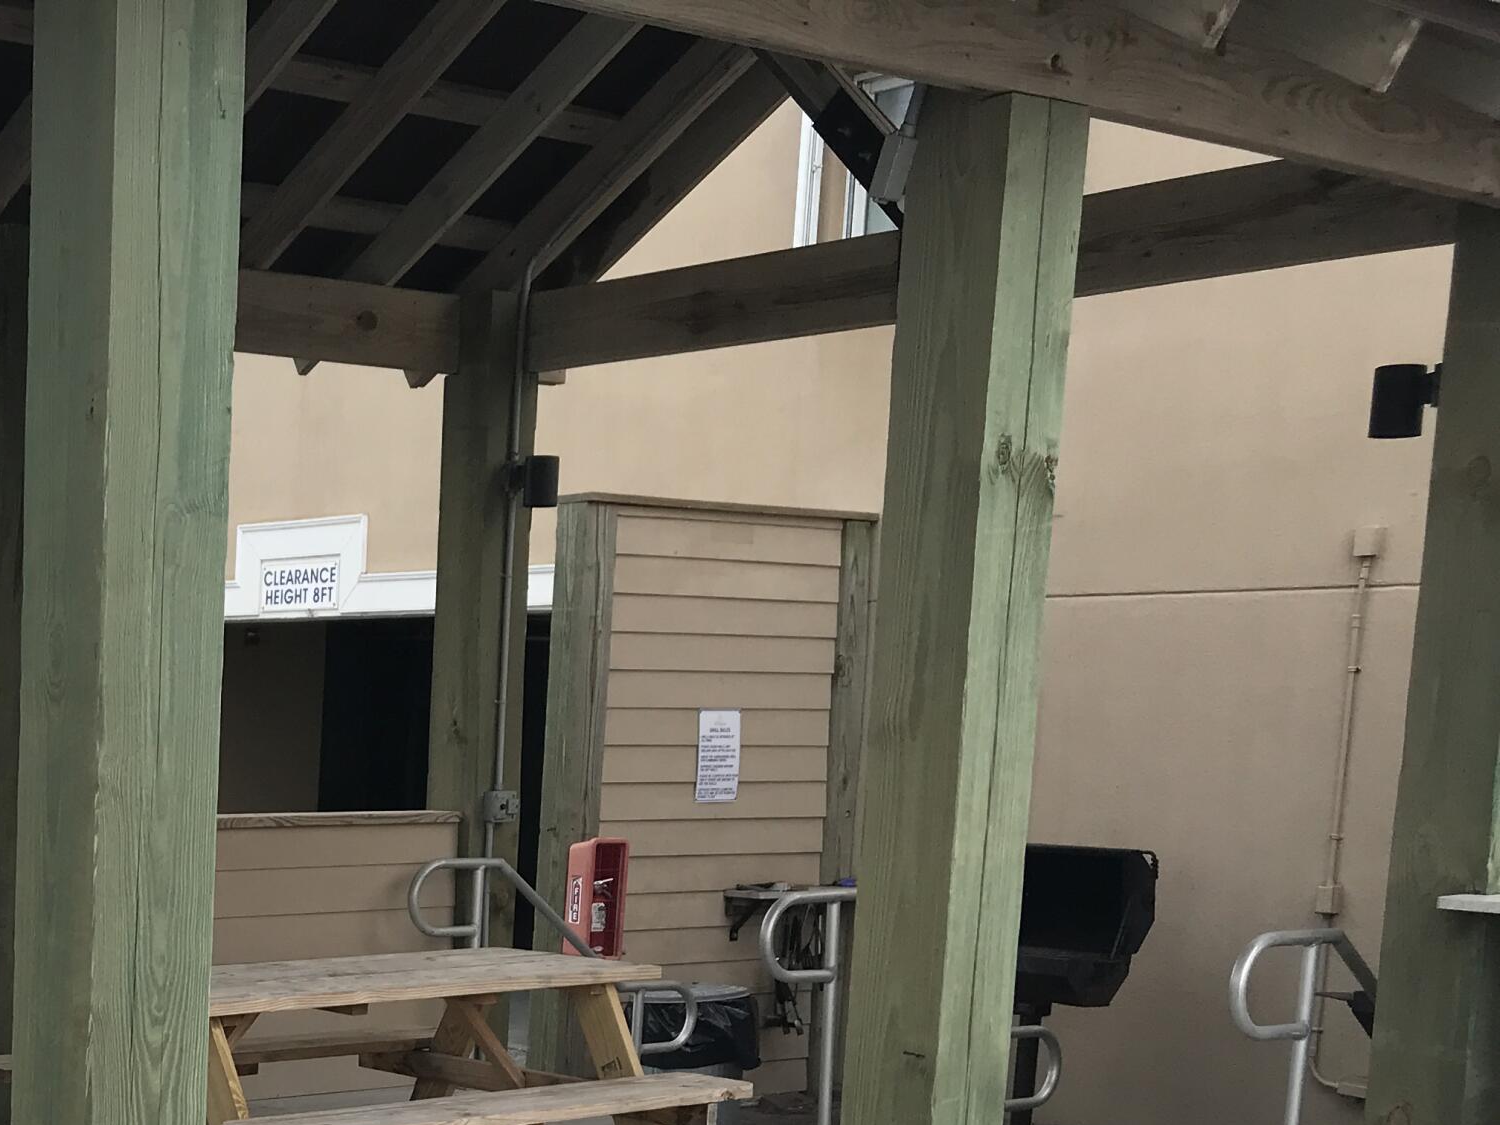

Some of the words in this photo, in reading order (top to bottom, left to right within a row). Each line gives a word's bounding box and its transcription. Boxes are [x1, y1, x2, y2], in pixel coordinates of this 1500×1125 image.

[264, 567, 336, 586] CLEARANCE
[266, 588, 308, 605] HEIGHT
[313, 587, 333, 603] 8FT
